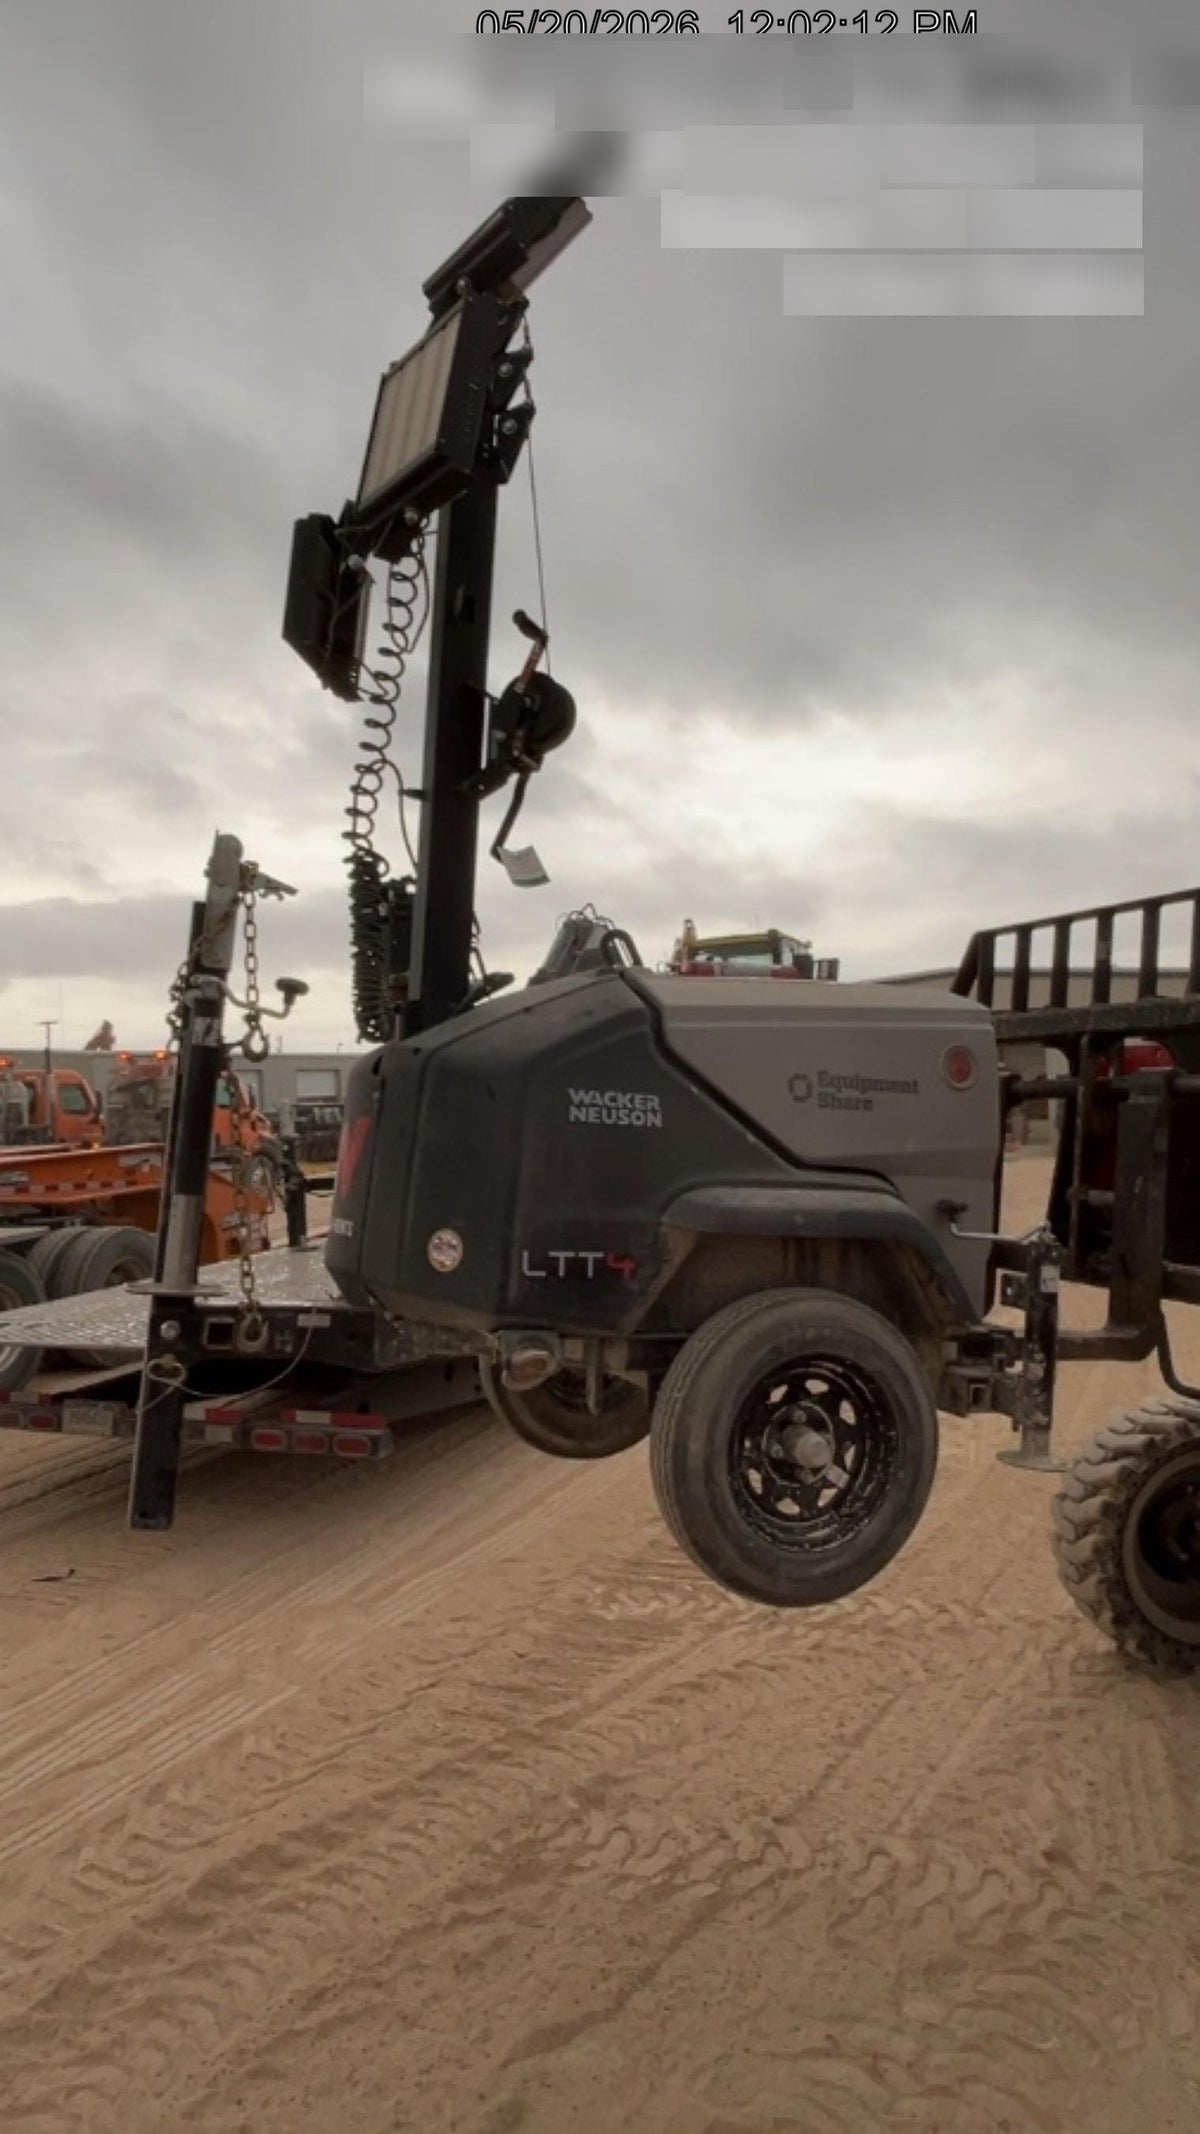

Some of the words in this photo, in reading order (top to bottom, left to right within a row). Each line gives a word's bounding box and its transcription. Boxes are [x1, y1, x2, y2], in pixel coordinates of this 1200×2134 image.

[817, 1069, 919, 1095] Equipment
[568, 1088, 661, 1110] WACKER
[817, 1092, 873, 1111] Share
[569, 1104, 662, 1127] NEUSON
[522, 1250, 634, 1279] LTT4
